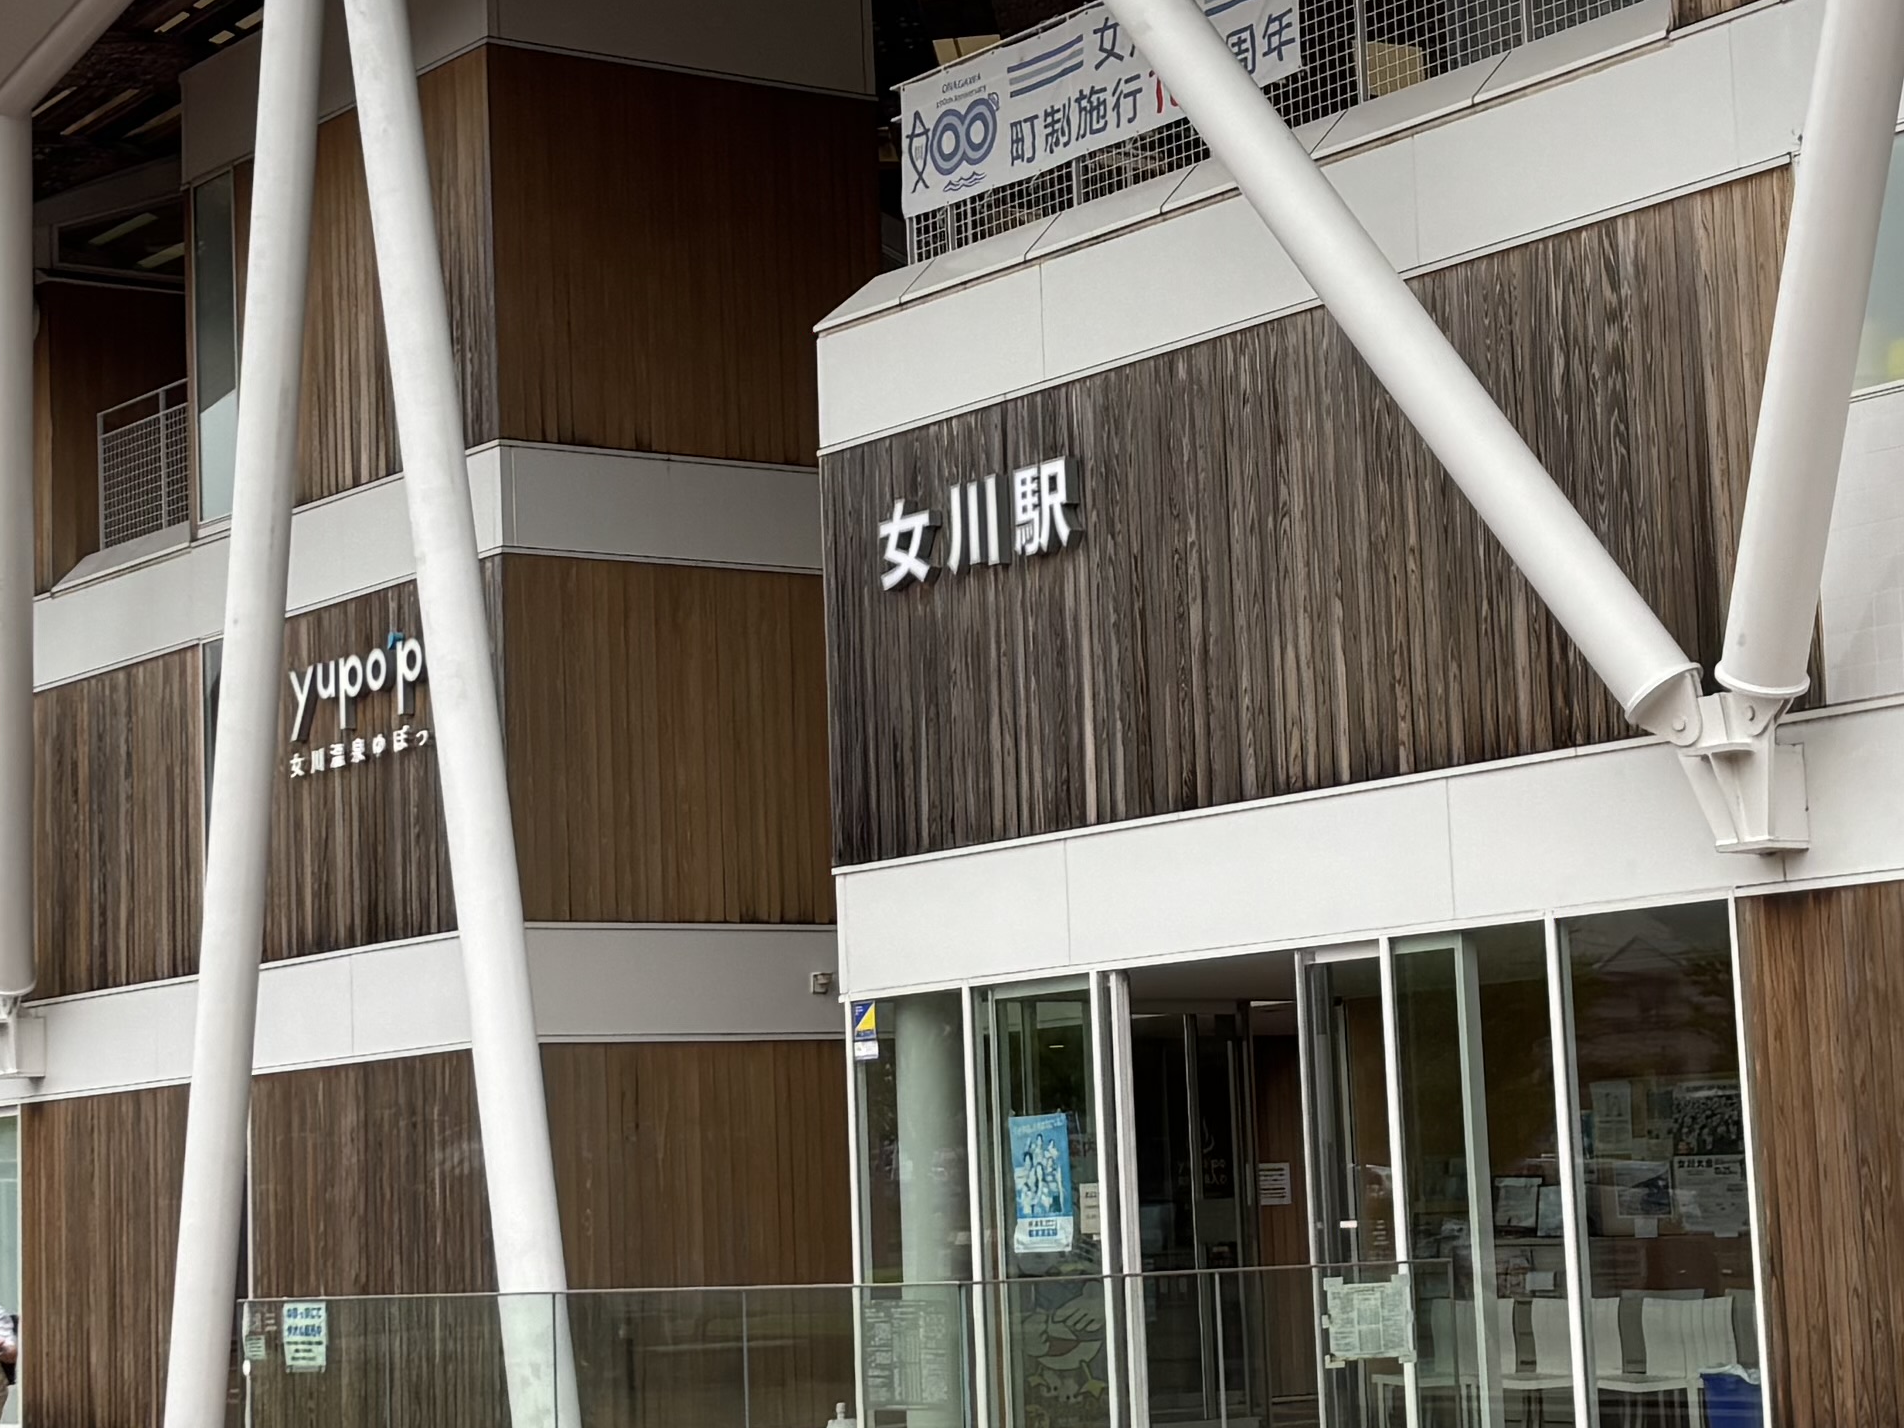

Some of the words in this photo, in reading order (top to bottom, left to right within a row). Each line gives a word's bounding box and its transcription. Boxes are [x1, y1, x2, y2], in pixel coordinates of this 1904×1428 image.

[878, 455, 1068, 591] 女川駅
[289, 632, 422, 743] yupo'p
[289, 724, 431, 779] 女川温泉ゆぽっ
